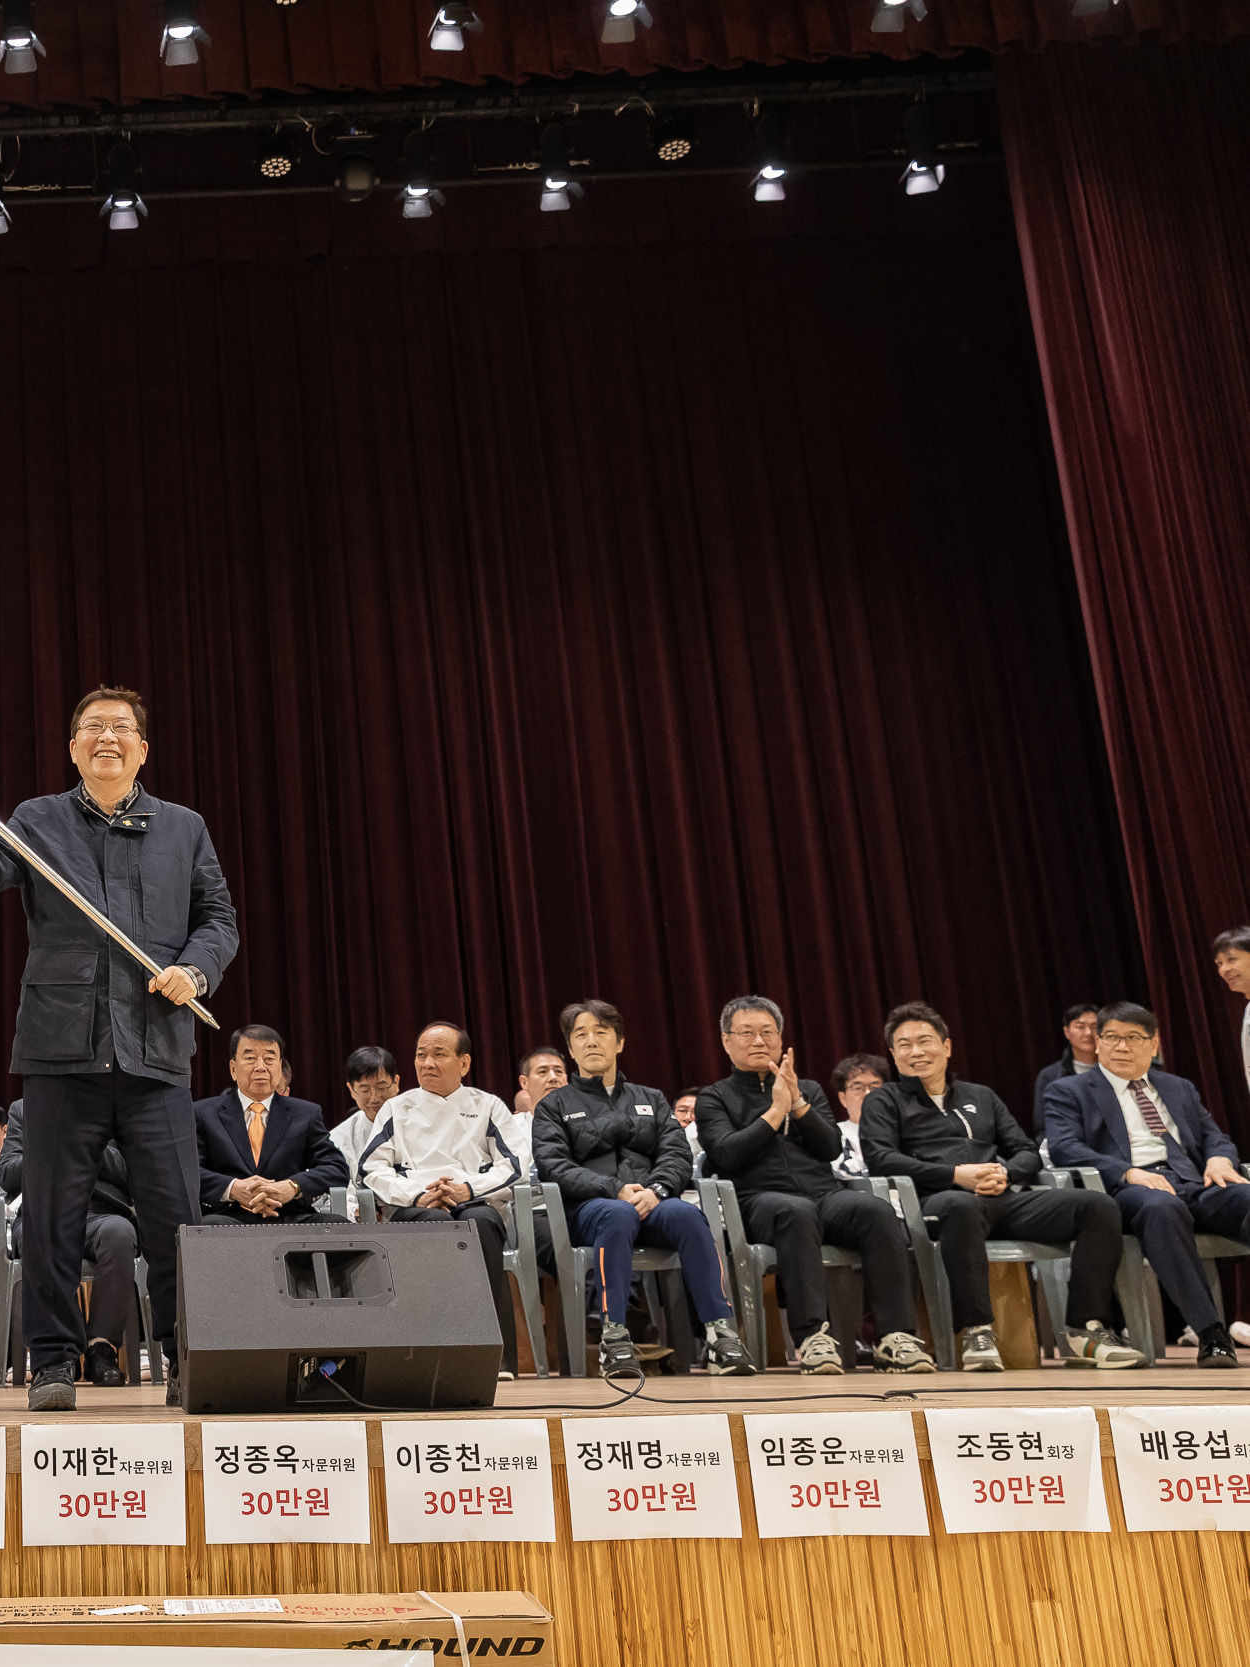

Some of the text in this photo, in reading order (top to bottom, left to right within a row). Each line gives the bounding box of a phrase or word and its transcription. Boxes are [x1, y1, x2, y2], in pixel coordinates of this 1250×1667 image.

[1234, 1444, 1250, 1457] 회
[242, 1488, 329, 1516] 30만원
[425, 1486, 513, 1515] 30만원
[608, 1482, 696, 1511] 30만원
[790, 1479, 881, 1508] 30만원
[973, 1475, 1065, 1504] 30만원
[59, 1490, 146, 1518] 30만원
[377, 1637, 545, 1657] HOUND
